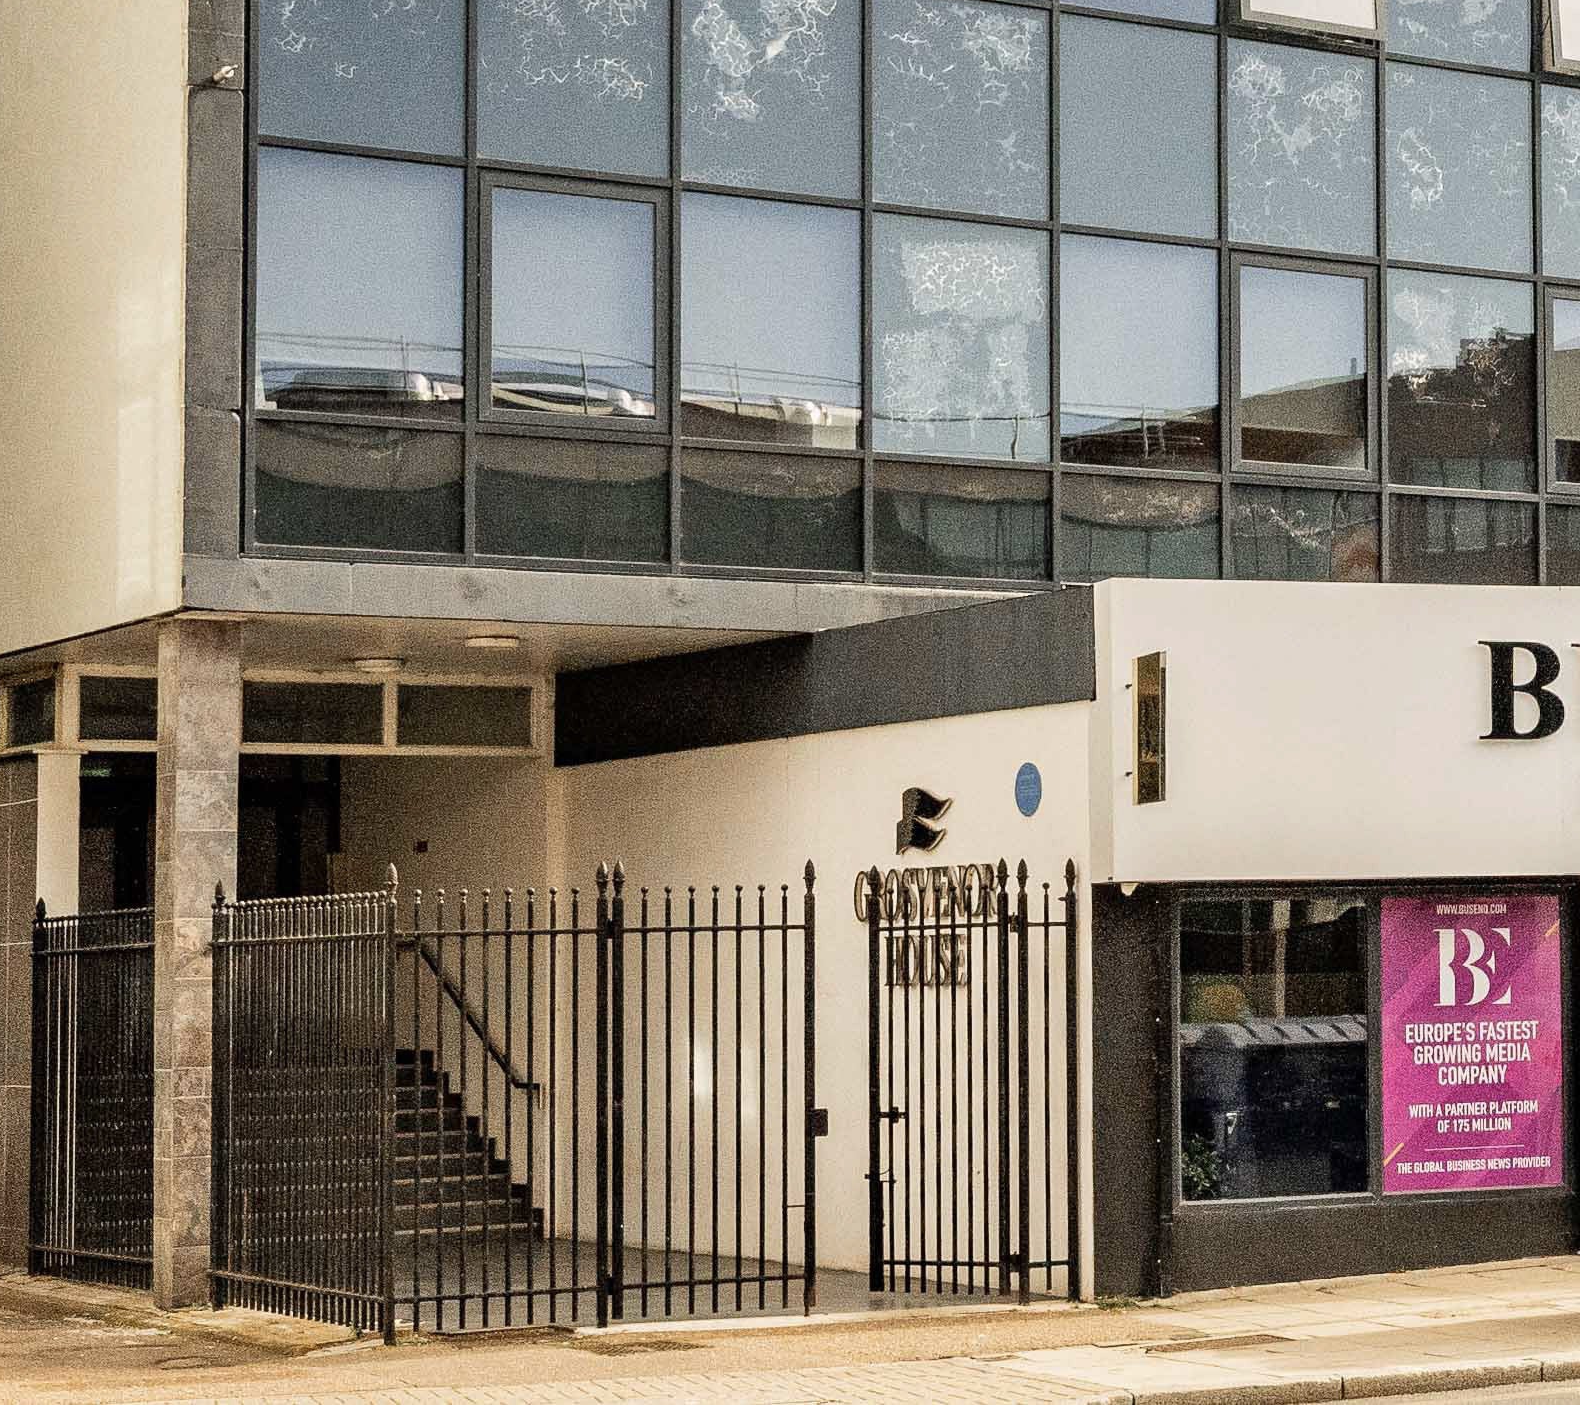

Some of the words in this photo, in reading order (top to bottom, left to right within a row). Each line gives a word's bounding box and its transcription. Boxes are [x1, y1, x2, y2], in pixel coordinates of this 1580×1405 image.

[1433, 927, 1512, 1007] BE
[1405, 1022, 1476, 1044] EUROPE'S
[1479, 1020, 1539, 1041] FASTEST
[1413, 1044, 1482, 1065] GROWING
[1486, 1042, 1531, 1062] MEDIA
[1438, 1064, 1508, 1086] COMPANY
[1408, 1103, 1434, 1118] WITH
[1435, 1103, 1443, 1117] A
[1444, 1101, 1487, 1117] PARTNER
[1489, 1099, 1539, 1115] PLATFORM
[1437, 1120, 1450, 1134] OF
[1452, 1118, 1471, 1133] 175
[1472, 1117, 1512, 1132] MILLION
[1396, 1162, 1413, 1175] THE
[1413, 1161, 1445, 1174] GLOBAL
[1446, 1159, 1486, 1173] BUSINESS
[1487, 1158, 1511, 1171] NEWS
[1512, 1155, 1551, 1169] PROVIDER
